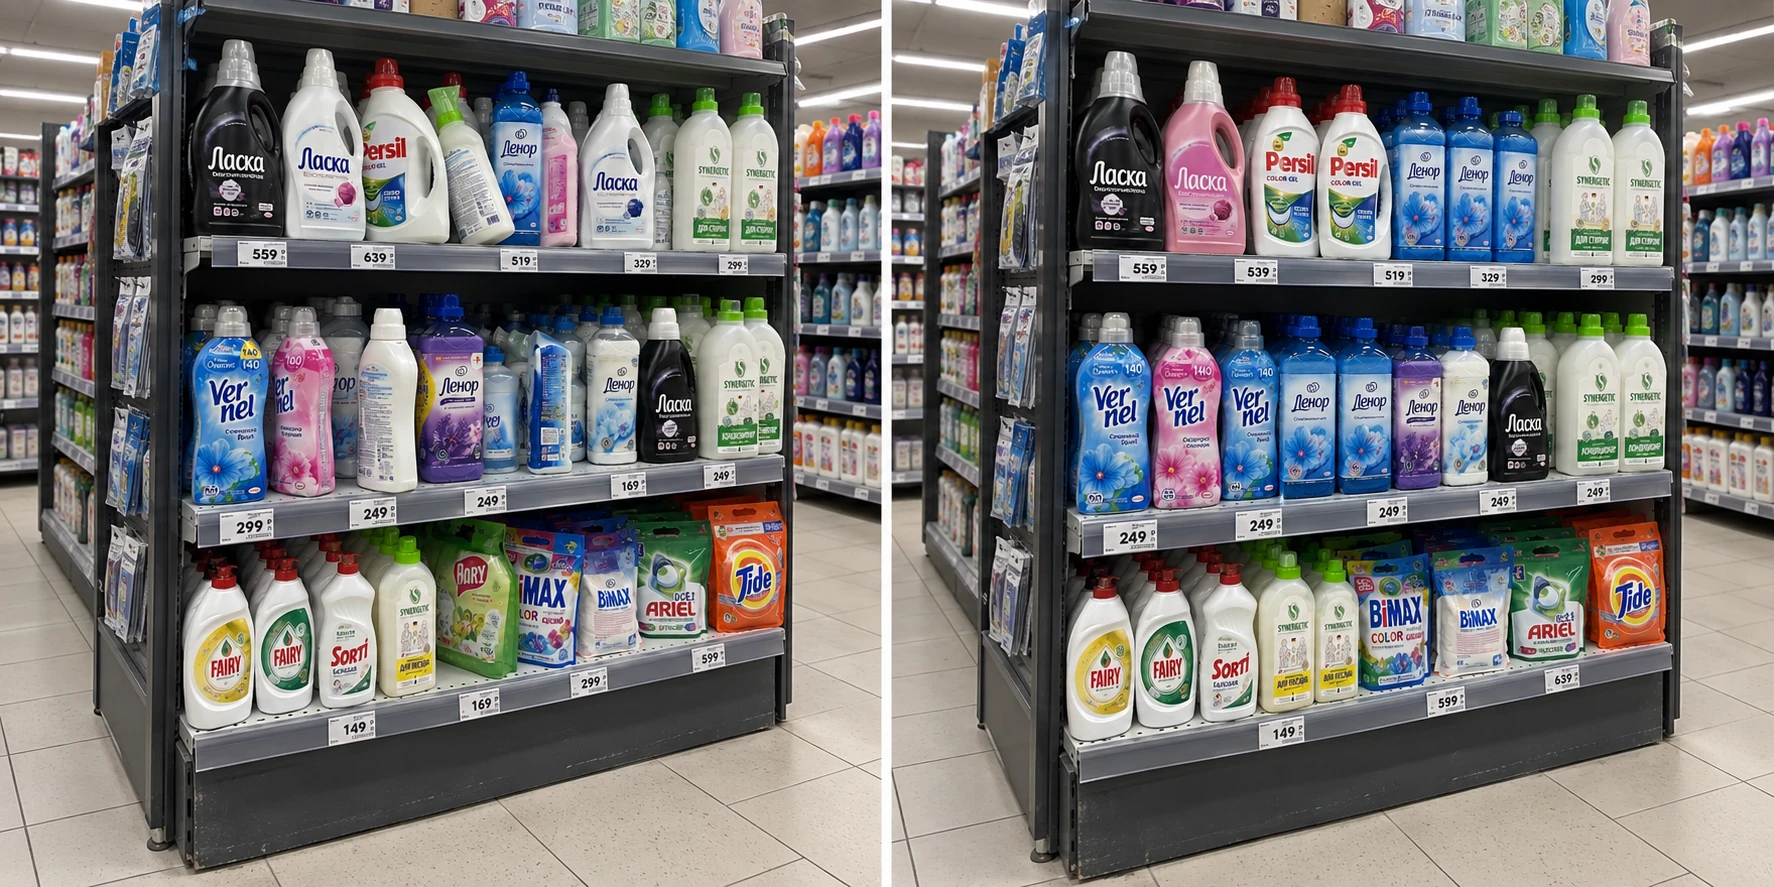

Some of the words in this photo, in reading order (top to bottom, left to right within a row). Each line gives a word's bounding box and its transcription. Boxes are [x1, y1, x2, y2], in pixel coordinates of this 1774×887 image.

[207, 146, 265, 173] Ласка
[298, 147, 350, 174] Ласка
[1265, 151, 1315, 175] Persil
[1330, 156, 1378, 178] Persil
[593, 171, 638, 191] Ласка
[1089, 160, 1147, 187] Ласка
[1174, 166, 1227, 192] Ласка
[252, 249, 277, 260] 559
[364, 252, 387, 263] 639
[511, 256, 531, 266] 519
[634, 259, 651, 268] 329
[727, 261, 743, 270] 299
[1133, 263, 1157, 274] 559
[1247, 267, 1270, 278] 539
[1385, 270, 1405, 281] 519
[1481, 273, 1500, 283] 329
[1590, 275, 1608, 284] 299
[209, 379, 248, 406] Ver
[439, 377, 479, 397] Ленор
[656, 393, 692, 413] Ласка
[1092, 385, 1131, 410] Ver
[1163, 385, 1199, 410] Ver
[1232, 386, 1265, 410] Ver
[220, 394, 254, 423] nel
[1104, 399, 1137, 428] nel
[1173, 400, 1206, 427] nel
[1242, 400, 1270, 428] nel
[1505, 413, 1542, 433] Ласка
[713, 470, 730, 481] 249
[622, 480, 639, 491] 169
[1587, 487, 1604, 498] 249
[477, 495, 499, 507] 249
[1491, 496, 1509, 508] 249
[363, 506, 388, 520] 249
[1379, 505, 1400, 518] 249
[236, 520, 263, 534] 299
[1250, 519, 1274, 532] 249
[1119, 531, 1147, 545] 249
[519, 575, 568, 609] iMAX
[736, 565, 772, 604] Tide
[598, 587, 632, 608] BiMAX
[1615, 580, 1652, 620] Tide
[646, 601, 696, 617] ARIEL
[1369, 595, 1422, 629] BiMAX
[1460, 608, 1498, 629] BiMAX
[1371, 631, 1404, 644] COLOR
[1527, 623, 1575, 640] ARIEL
[274, 644, 302, 668] FAIRY
[701, 652, 719, 664] 599
[211, 655, 242, 679] FAIRY
[1153, 657, 1183, 680] FAIRY
[581, 677, 600, 688] 299
[1090, 666, 1121, 689] FAIRY
[1554, 673, 1572, 685] 639
[472, 698, 492, 712] 169
[1438, 695, 1458, 709] 599
[343, 722, 366, 736] 149
[1273, 726, 1295, 740] 149
